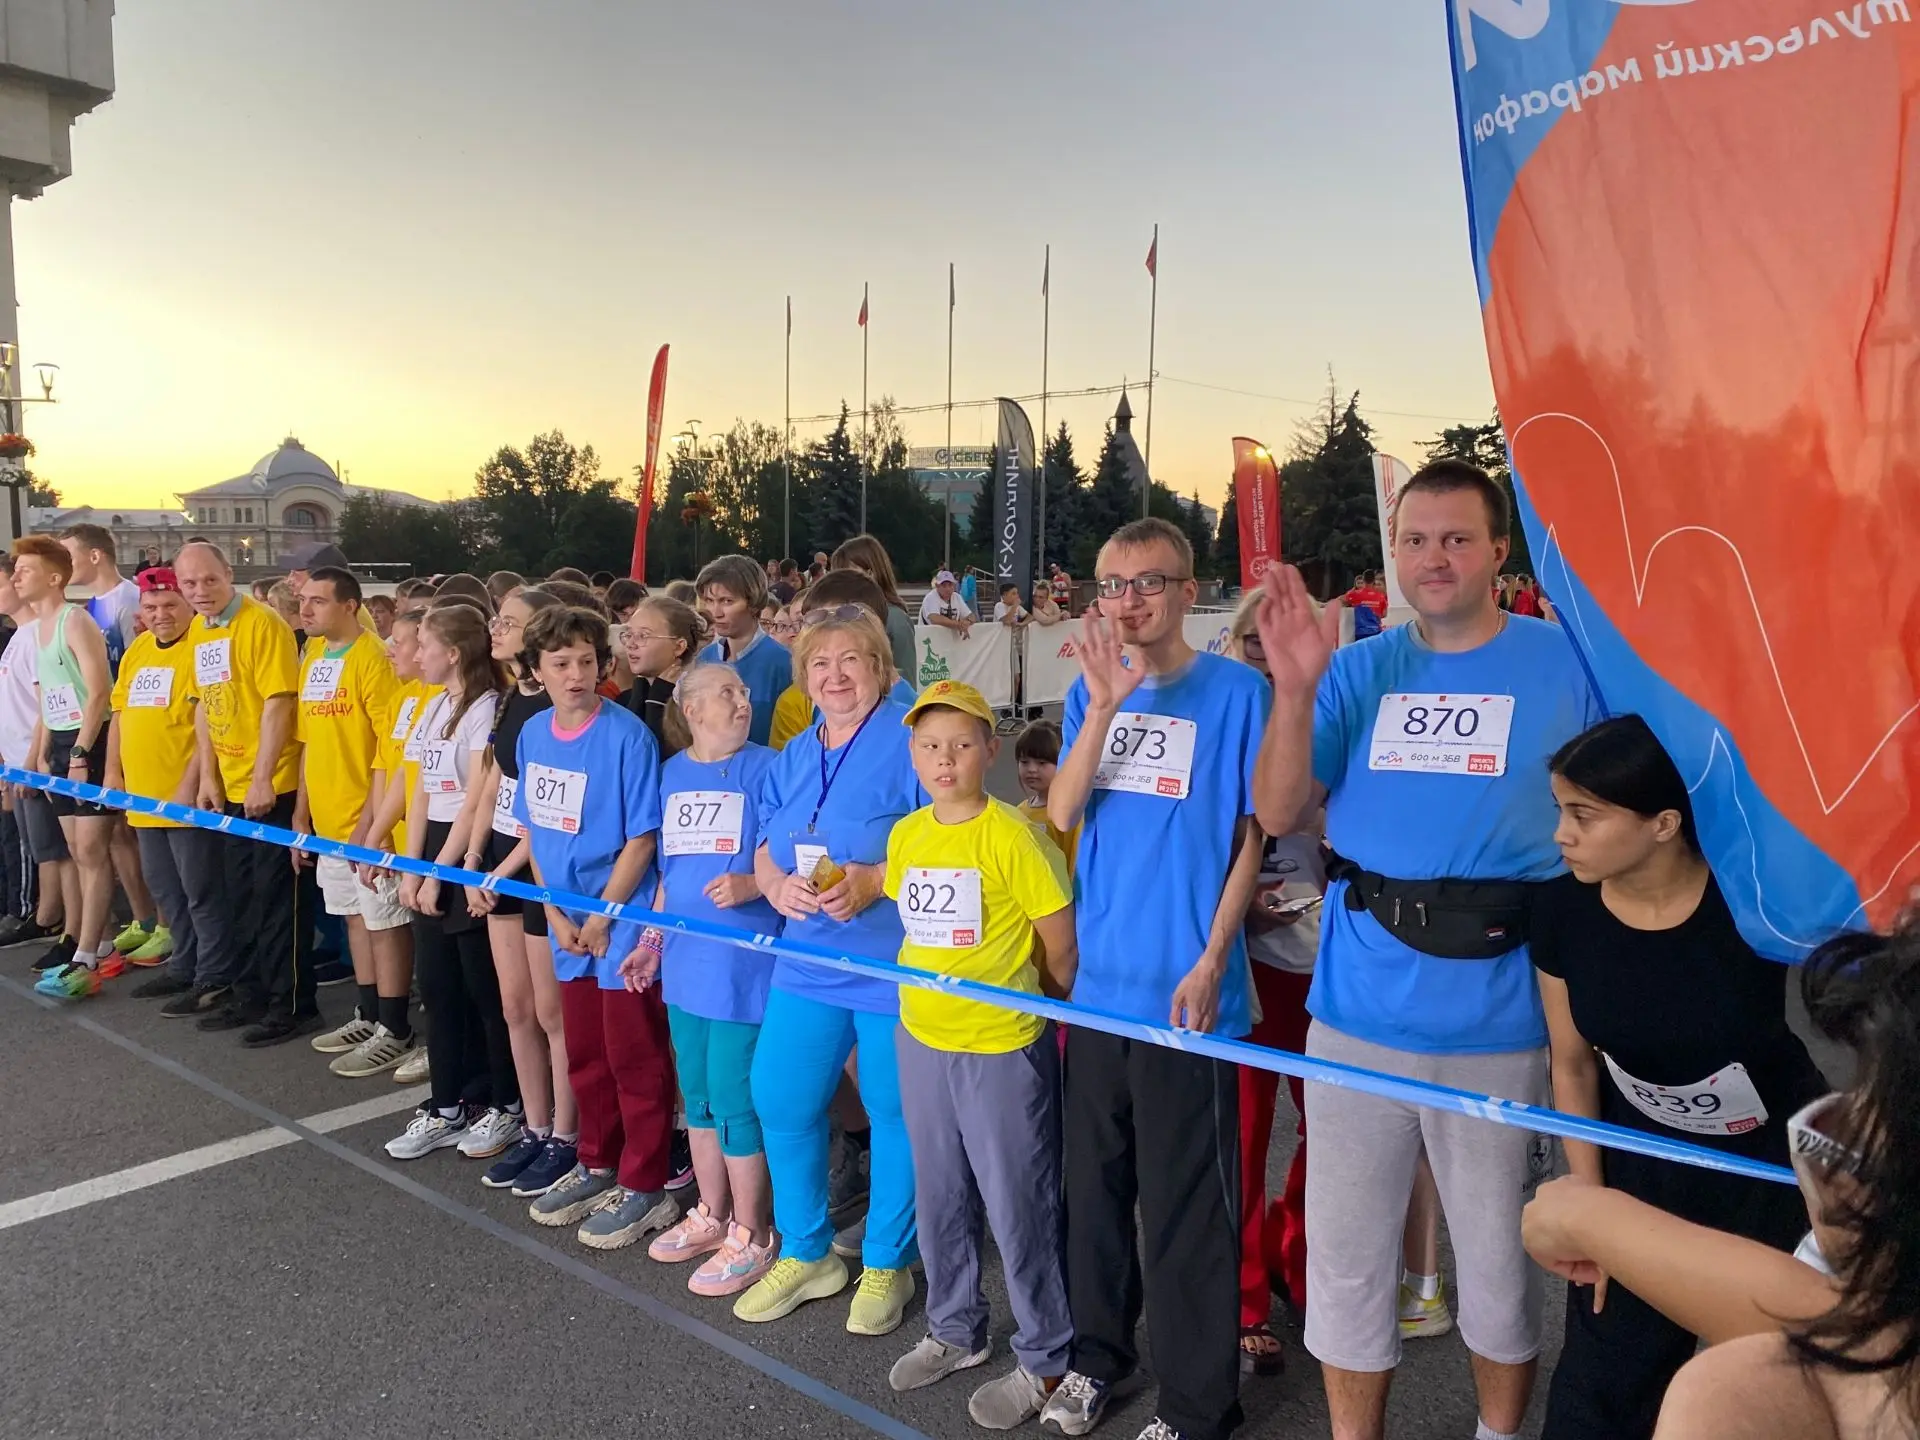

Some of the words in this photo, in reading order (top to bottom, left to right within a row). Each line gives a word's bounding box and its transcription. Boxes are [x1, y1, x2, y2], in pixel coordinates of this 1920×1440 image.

[201, 647, 222, 668] 865
[135, 674, 161, 690] 866
[310, 666, 333, 683] 852
[47, 693, 68, 711] 814
[1403, 706, 1479, 737] 870
[1110, 726, 1167, 760] 873
[423, 749, 442, 770] 837
[1410, 753, 1429, 761] 600
[535, 777, 566, 805] 871
[678, 803, 722, 828] 877
[908, 883, 957, 914] 822
[1631, 1084, 1722, 1115] 839
